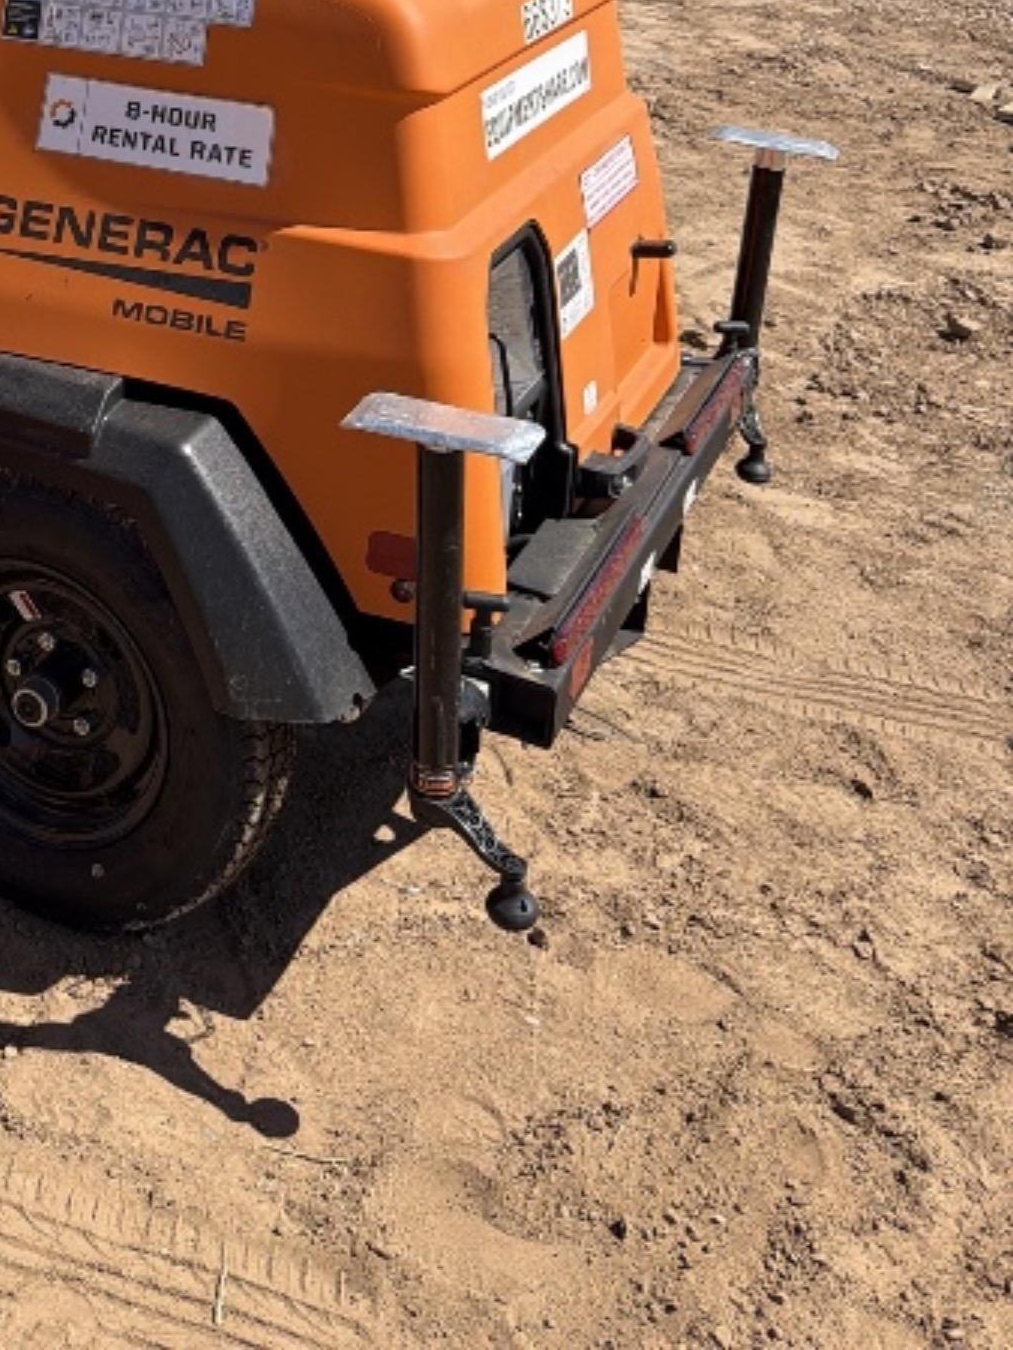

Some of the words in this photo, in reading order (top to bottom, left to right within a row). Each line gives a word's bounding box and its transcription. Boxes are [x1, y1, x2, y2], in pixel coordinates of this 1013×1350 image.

[125, 100, 217, 132] 8-HOUR
[91, 124, 180, 157] RENTAL
[190, 140, 253, 169] RATE
[112, 298, 247, 342] MOBILE
